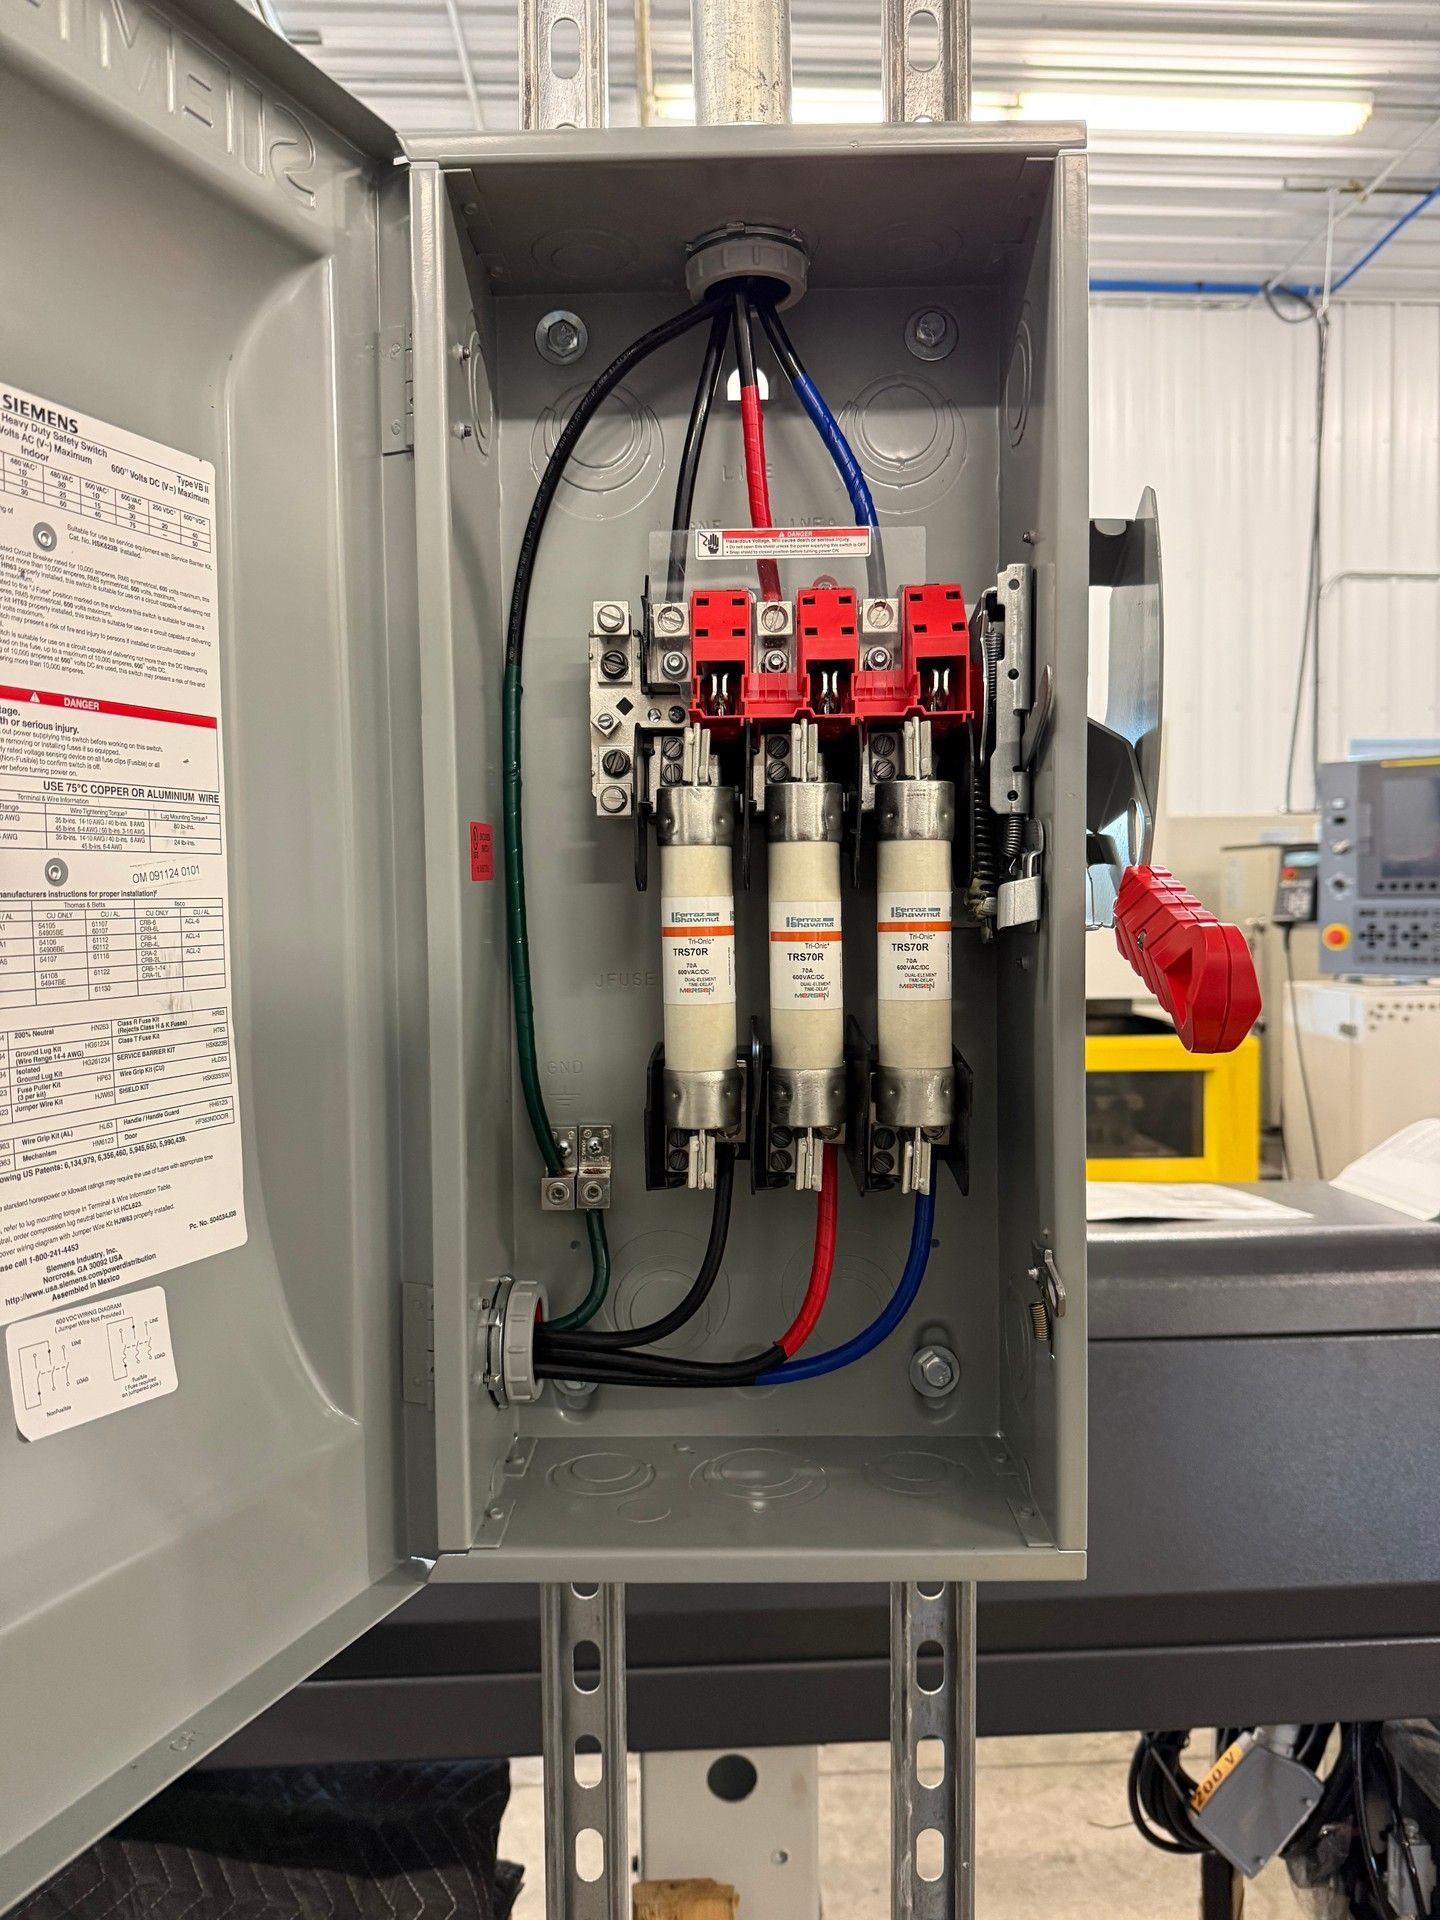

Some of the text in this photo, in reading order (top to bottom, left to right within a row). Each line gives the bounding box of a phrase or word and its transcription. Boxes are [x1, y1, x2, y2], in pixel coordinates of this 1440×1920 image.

[2, 393, 79, 434] SIEMENS
[1, 412, 108, 458] Heavy Duty Safety Switch
[20, 445, 49, 462] Indoor
[21, 433, 35, 445] AC
[54, 444, 93, 465] Maximum
[722, 463, 774, 482] LIE
[129, 470, 148, 484] Volts
[149, 477, 161, 488] DC
[177, 487, 210, 505] Maximum
[176, 475, 193, 490] Type
[193, 481, 204, 492] VB
[63, 697, 100, 711] DANGER
[11, 719, 21, 727] or
[22, 720, 53, 731] serious
[55, 722, 80, 735] injury.
[13, 730, 31, 738] power
[33, 731, 60, 741] supplying
[61, 733, 71, 741] this
[72, 735, 89, 744] switch
[90, 737, 107, 746] before
[108, 741, 128, 749] working
[43, 780, 220, 803] USE 75°C COPPER OR ALUMINIUM WIRE
[132, 864, 200, 884] OM 091124 0101
[48, 890, 87, 898] instructions
[88, 889, 98, 898] for
[99, 891, 119, 899] proper
[64, 901, 85, 909] Thomas
[673, 947, 709, 956] TRS70R
[892, 942, 929, 951] TRS70R
[787, 952, 824, 961] TRS70R
[679, 986, 715, 995] MERSEN
[898, 981, 936, 991] MERSEN
[794, 990, 830, 1000] MERSEN
[14, 1028, 55, 1040] 200% Neutral
[15, 1045, 62, 1058] Ground Lug Kit
[15, 1058, 33, 1067] (Wire
[33, 1056, 52, 1064] Range
[67, 1050, 85, 1059] AWG)
[116, 1046, 176, 1061] SERVICE BARRIER KIT
[16, 1066, 41, 1076] Isolated
[547, 1059, 584, 1076] GND
[16, 1070, 63, 1084] Ground Lug Kit
[17, 1081, 61, 1094] Fuse Puller Kit
[118, 1083, 150, 1094] SHIELD KIT
[15, 1098, 63, 1113] Jumper Wire Kit
[21, 1130, 74, 1146] Wire Grip Kit (AL)
[22, 1169, 33, 1178] US
[35, 1164, 64, 1176] Patents:
[64, 1156, 97, 1170] 6,134,979,
[15, 1243, 80, 1267] call 1-800-241-4453
[46, 1247, 118, 1274] Siemens Industry, Inc.
[42, 1253, 124, 1285] Norcross, GA 30092 USA
[5, 1253, 157, 1306] http://www.usa.siemens.com/powerdistribution
[51, 1284, 89, 1302] Assembled
[97, 1274, 121, 1286] Mexico
[77, 1309, 97, 1320] WIRING
[97, 1302, 122, 1314] DIAGRAM
[1224, 1751, 1234, 1764] V
